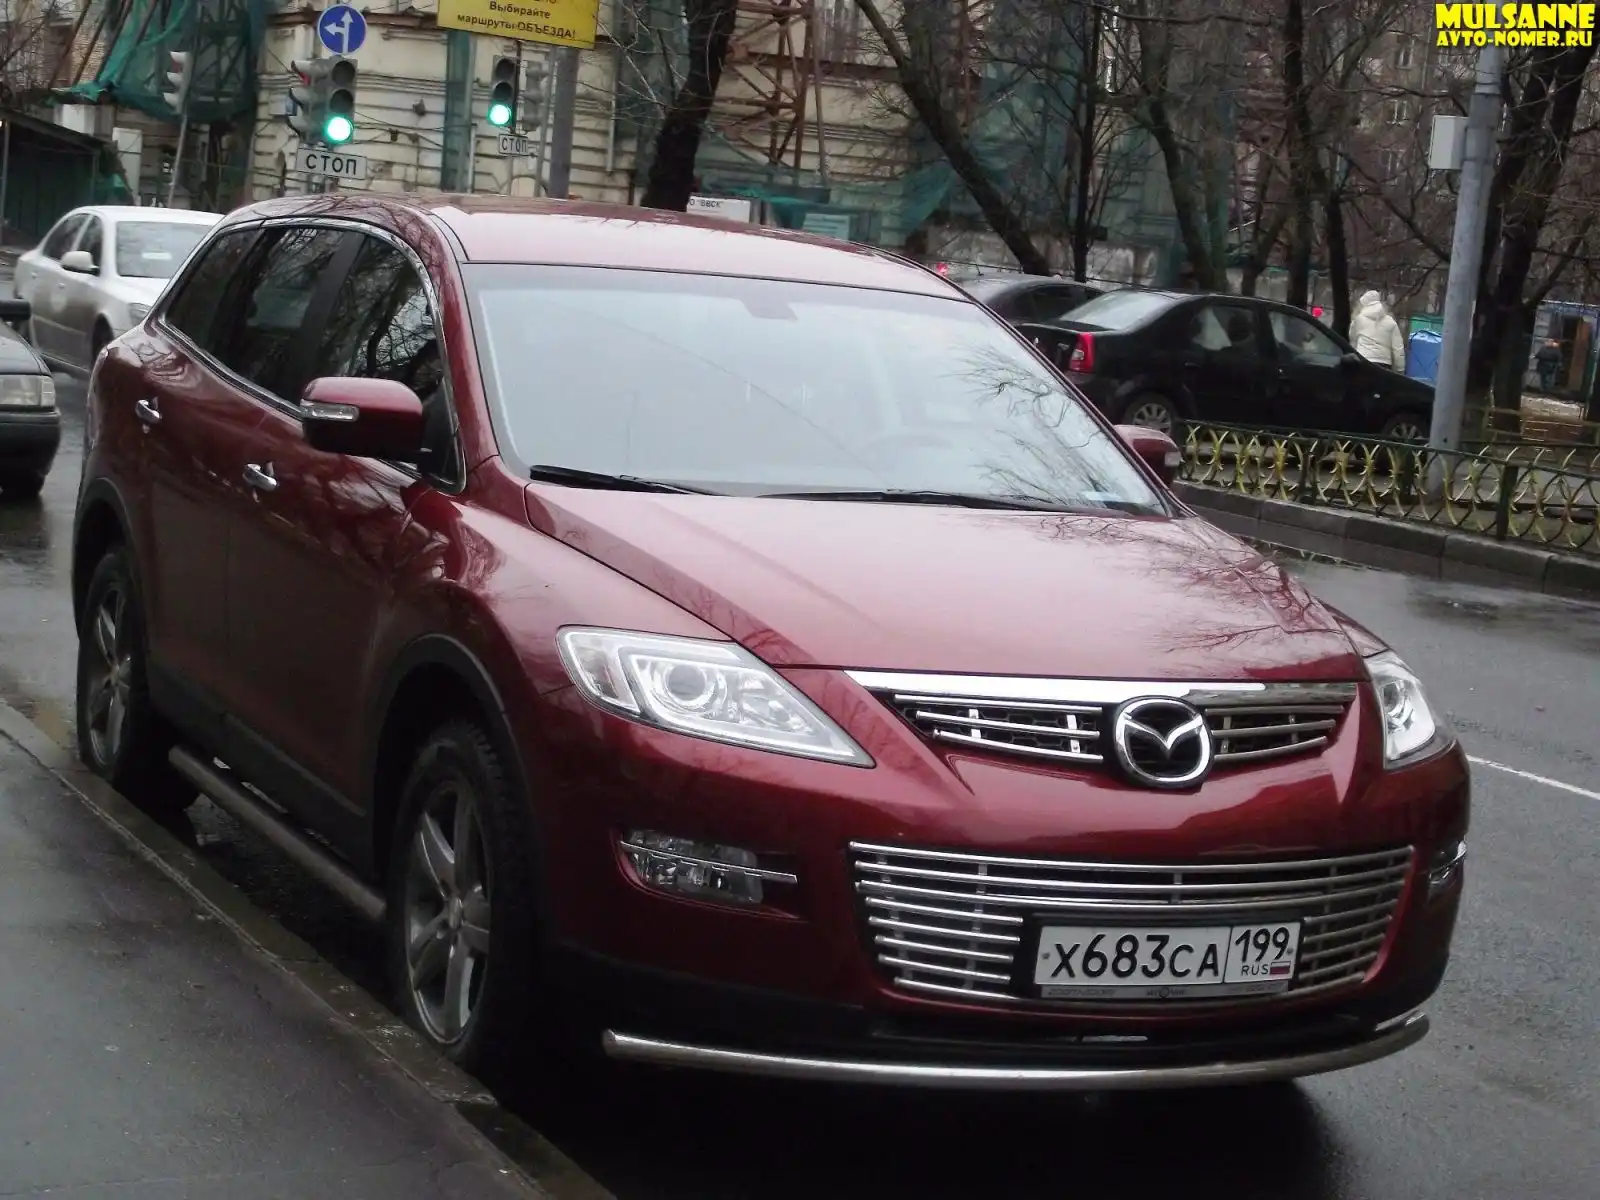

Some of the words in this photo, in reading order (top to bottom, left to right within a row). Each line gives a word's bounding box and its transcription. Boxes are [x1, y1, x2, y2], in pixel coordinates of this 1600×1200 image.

[489, 1, 551, 19] Выбирайте
[457, 14, 515, 30] маршруты
[516, 21, 576, 39] ОБЪЕЗДА!
[501, 137, 527, 153] СТОП
[306, 154, 357, 175] СТОП
[1051, 934, 1220, 979] Х683СА
[1235, 927, 1290, 963] 199
[1241, 964, 1269, 976] RUS
